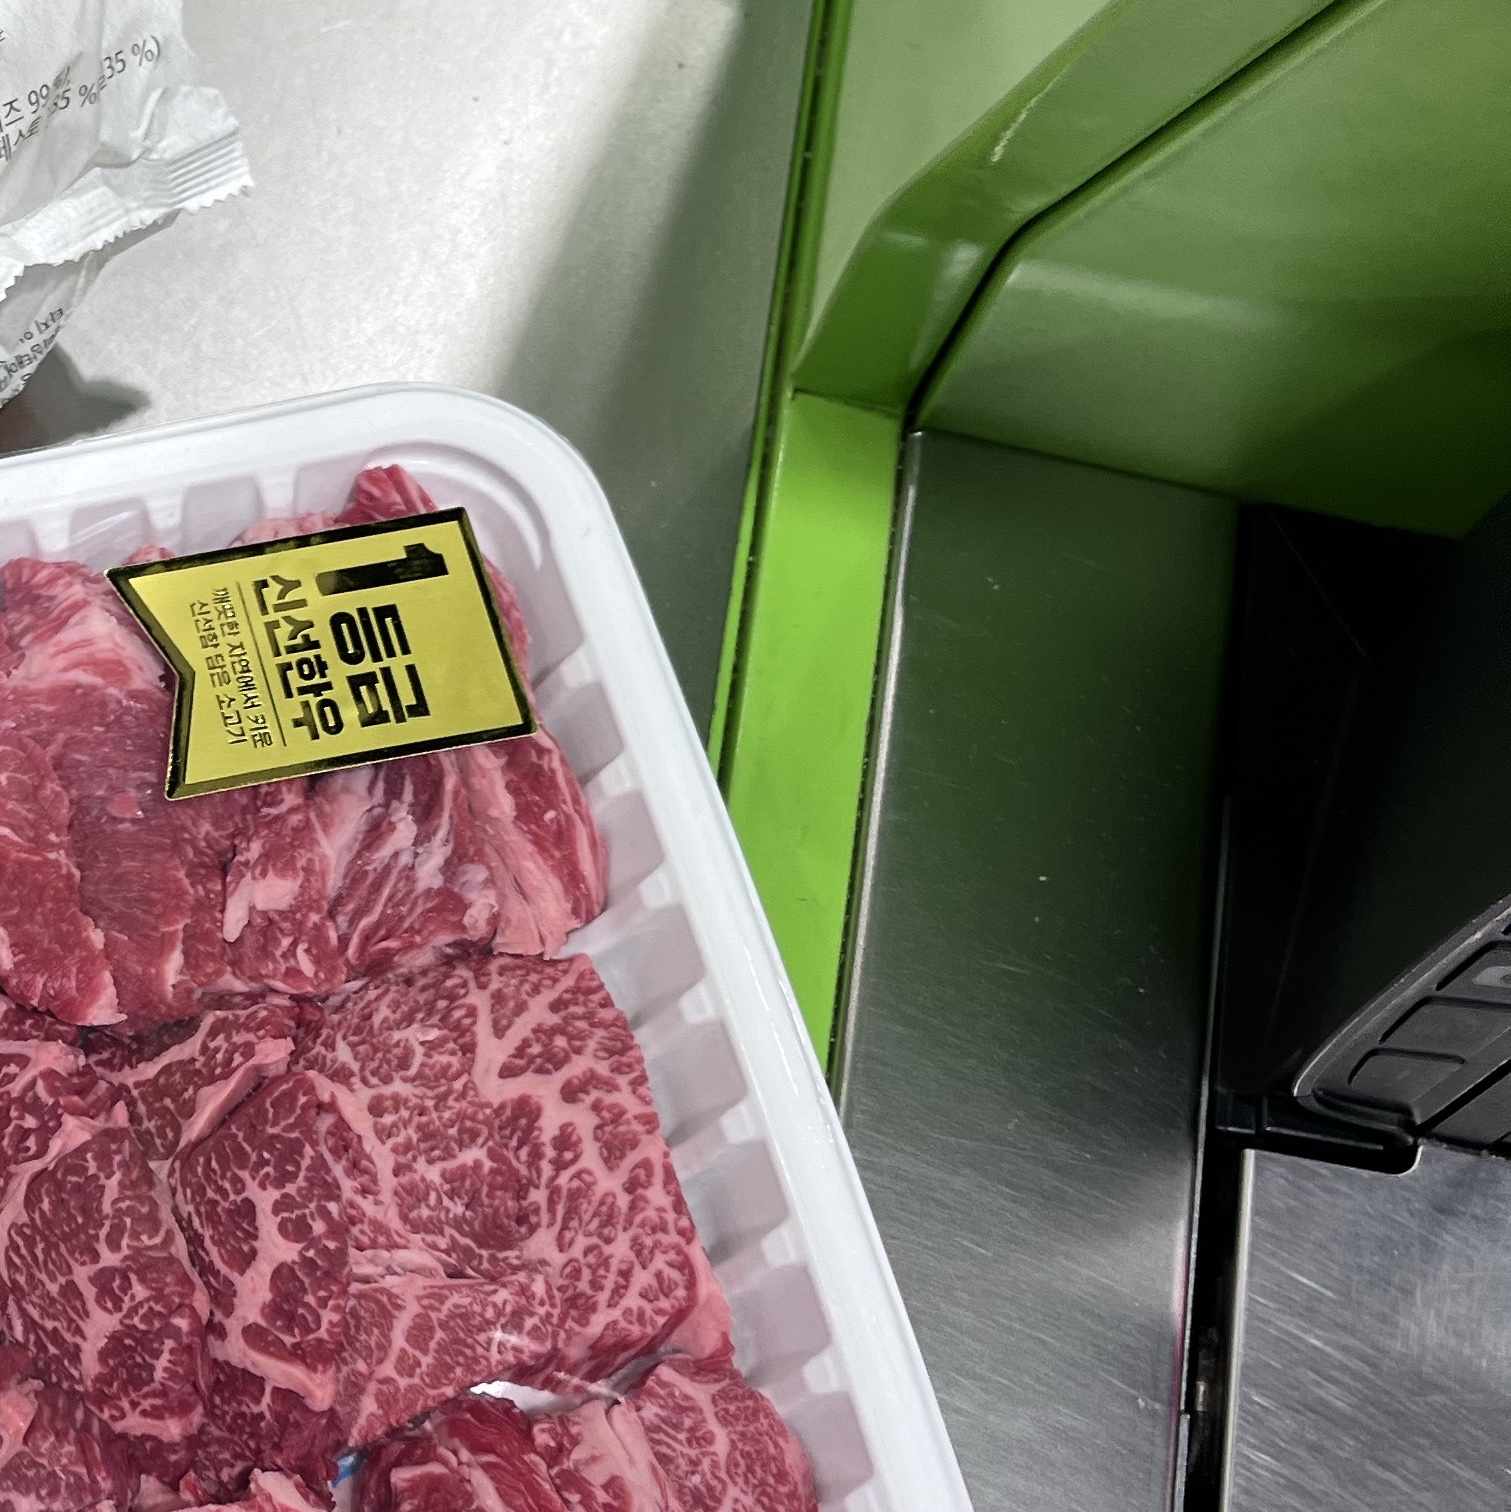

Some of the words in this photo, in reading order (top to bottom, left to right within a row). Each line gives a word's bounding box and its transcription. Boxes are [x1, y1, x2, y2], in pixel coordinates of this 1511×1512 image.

[190, 602, 220, 648] 신선함
[251, 575, 344, 740] 신선한우
[315, 543, 449, 727] 1등급
[205, 654, 231, 687] 담은
[227, 642, 261, 709] 자연에서
[246, 714, 273, 748] 키운
[216, 694, 247, 744] 소고기
